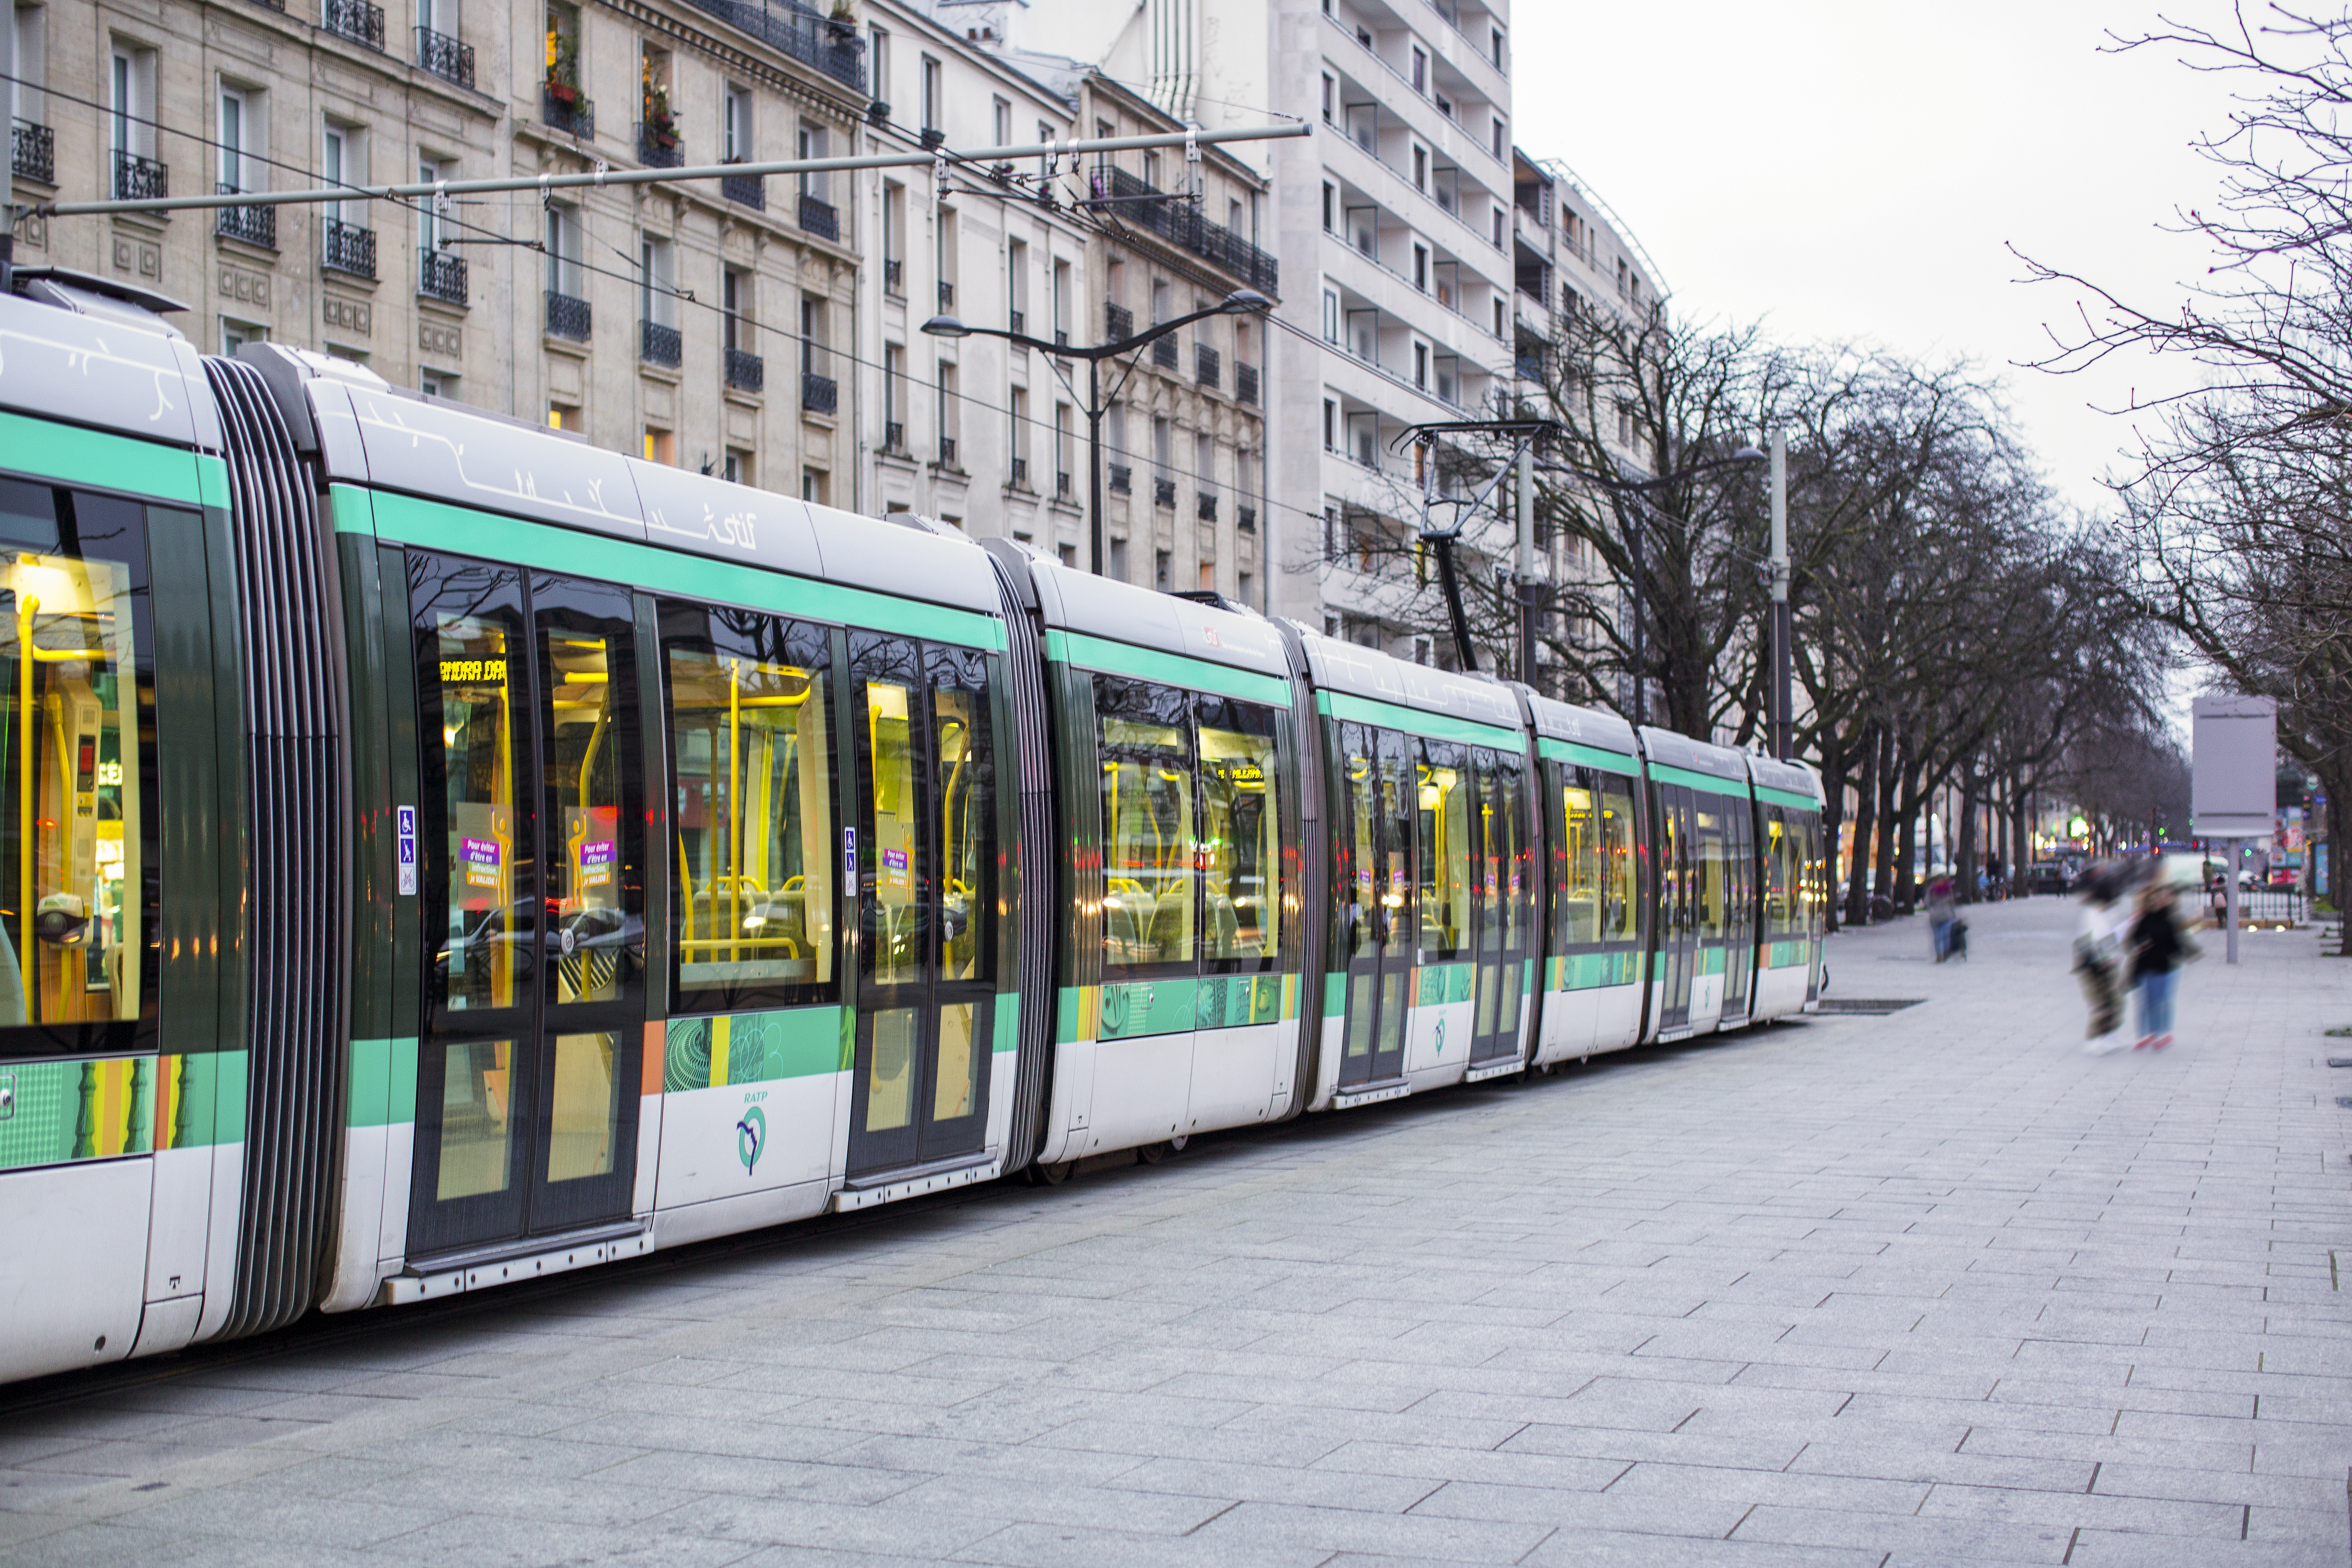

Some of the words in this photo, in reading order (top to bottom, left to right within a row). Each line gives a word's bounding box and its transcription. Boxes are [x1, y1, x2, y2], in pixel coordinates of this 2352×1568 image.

[468, 839, 480, 850] Pour
[481, 841, 495, 853] éviter
[585, 844, 595, 854] Pour
[597, 842, 609, 852] éviter
[486, 854, 492, 863] en
[601, 853, 607, 862] en
[744, 1090, 768, 1103] RATP
